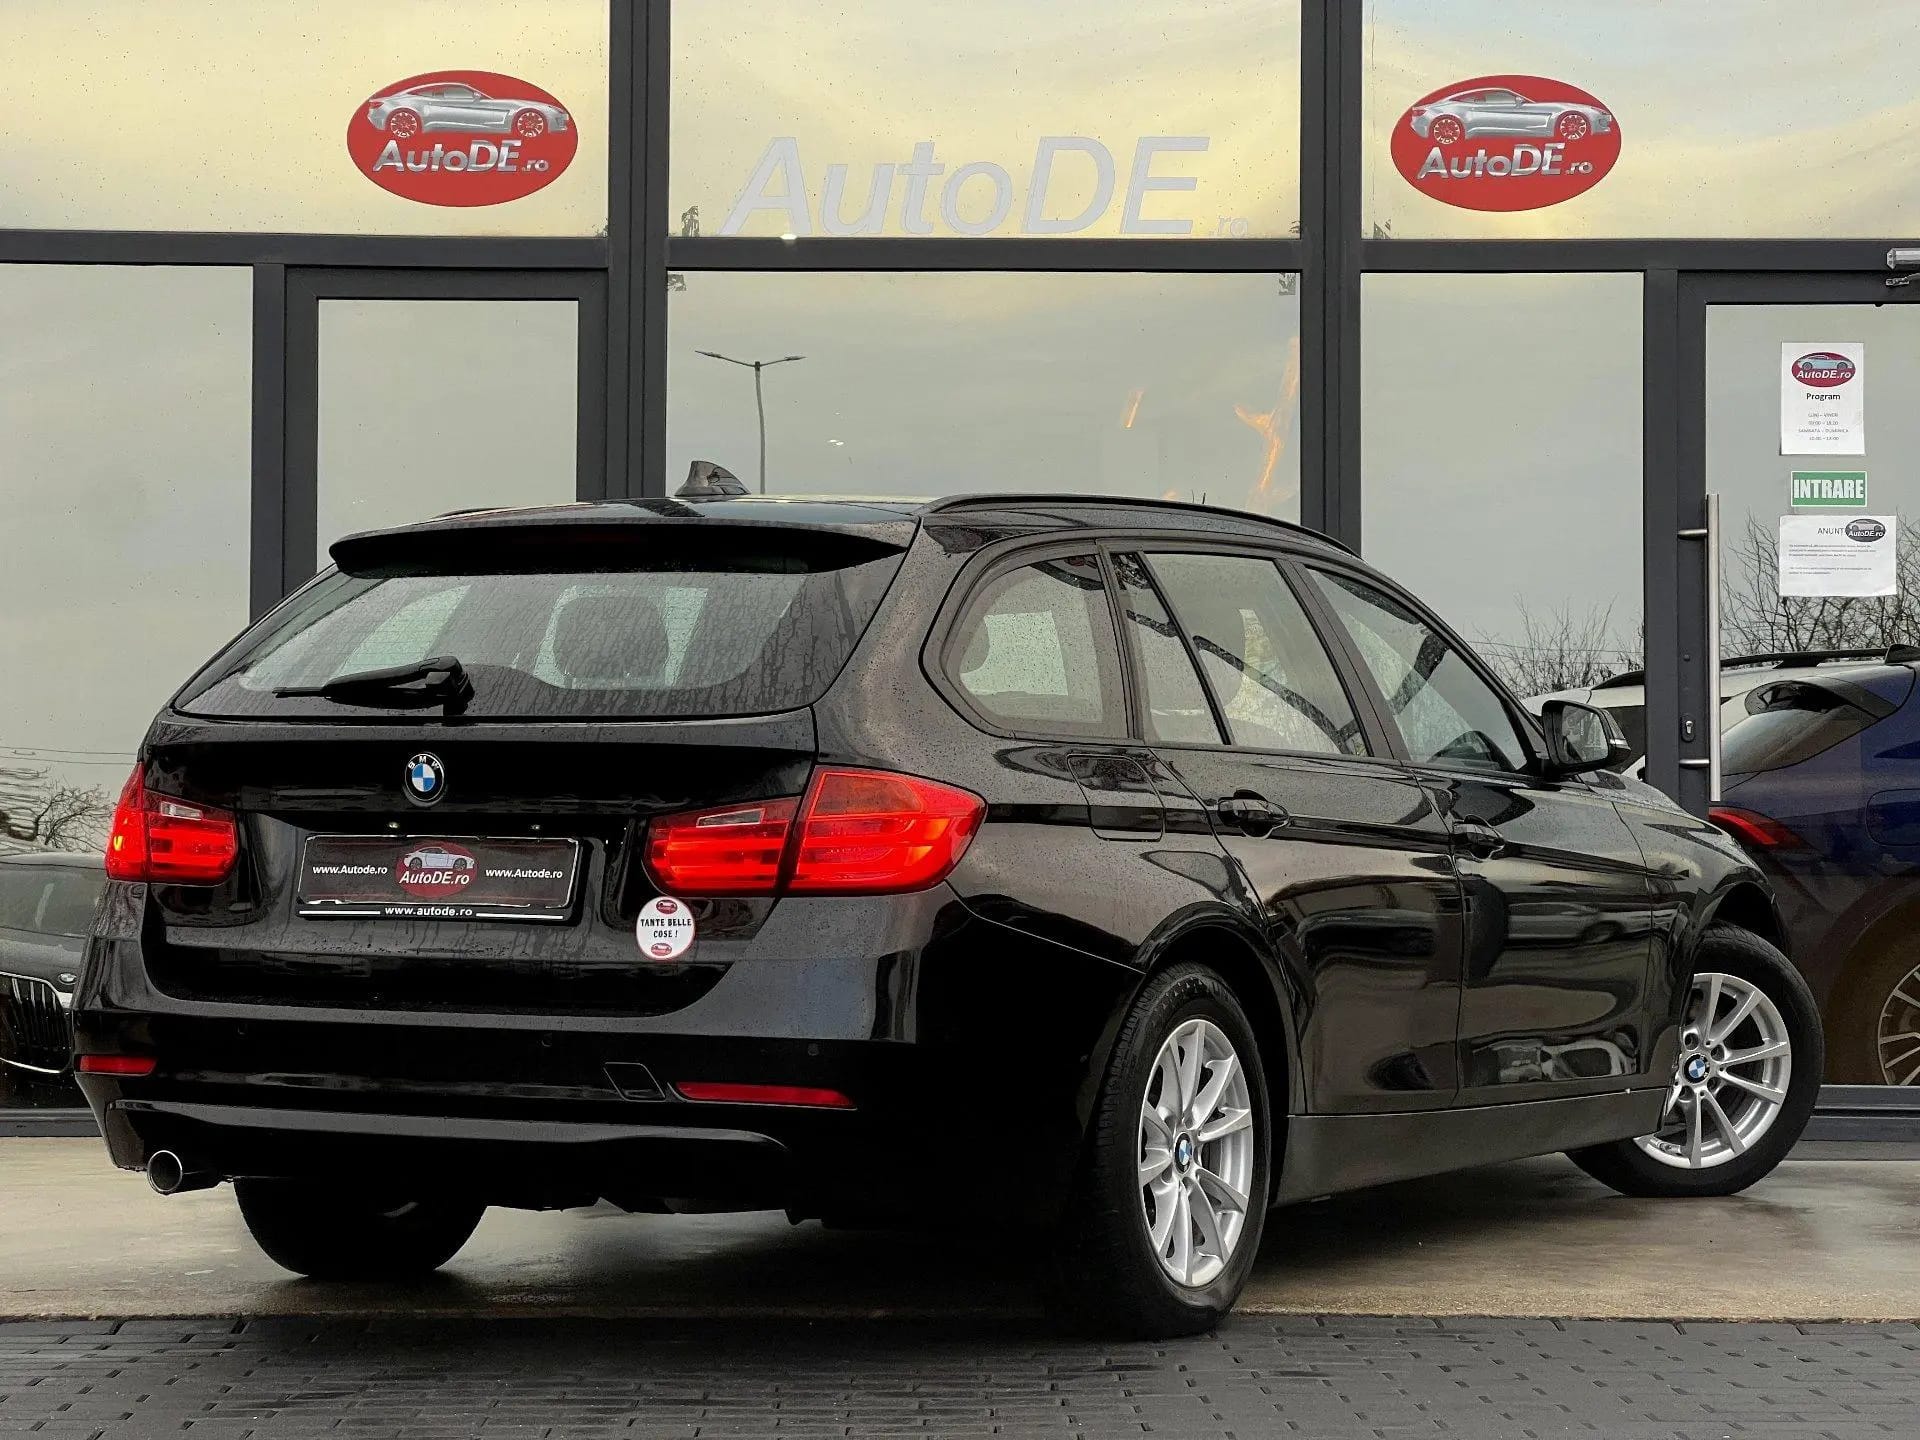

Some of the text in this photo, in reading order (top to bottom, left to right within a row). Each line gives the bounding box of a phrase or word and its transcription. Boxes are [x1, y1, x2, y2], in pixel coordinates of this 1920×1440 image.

[1796, 370, 1852, 379] AutoDE.ro
[1806, 393, 1841, 401] Program
[1794, 479, 1864, 499] INTRARE
[1848, 529, 1884, 537] AutoDE.ro
[313, 864, 388, 875] www.Autode.ro
[485, 867, 563, 879] www.Autode.ro
[399, 870, 470, 885] AutoDE.ro
[385, 905, 473, 917] www.autode.ro
[640, 918, 692, 927] TANTE BELLE
[653, 930, 673, 938] COSE
